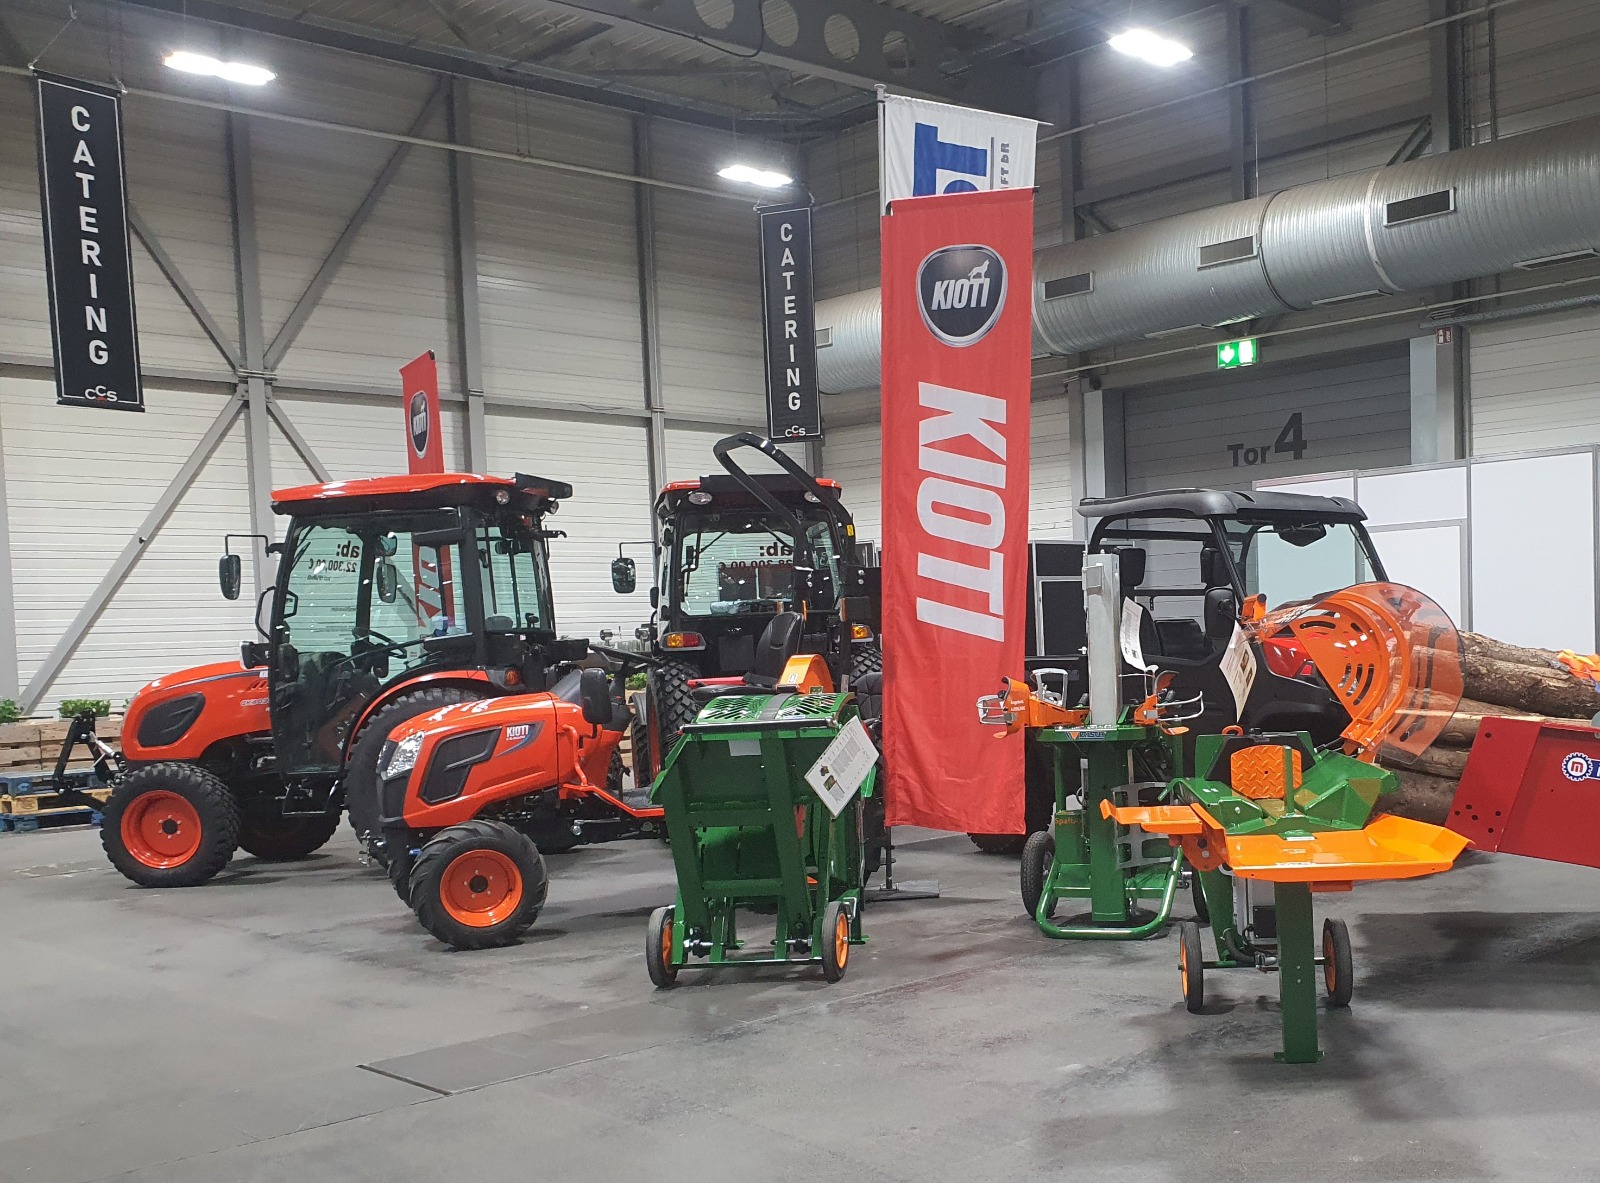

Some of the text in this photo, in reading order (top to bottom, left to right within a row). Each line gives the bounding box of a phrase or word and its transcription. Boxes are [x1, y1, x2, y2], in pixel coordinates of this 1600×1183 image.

[913, 123, 987, 197] T
[71, 105, 108, 366] CATERING
[780, 223, 801, 411] CATERING
[931, 278, 990, 310] KIOTI
[1227, 412, 1307, 467] Tor 4
[916, 382, 1006, 642] KIOTI
[507, 725, 529, 737] KIOTI
